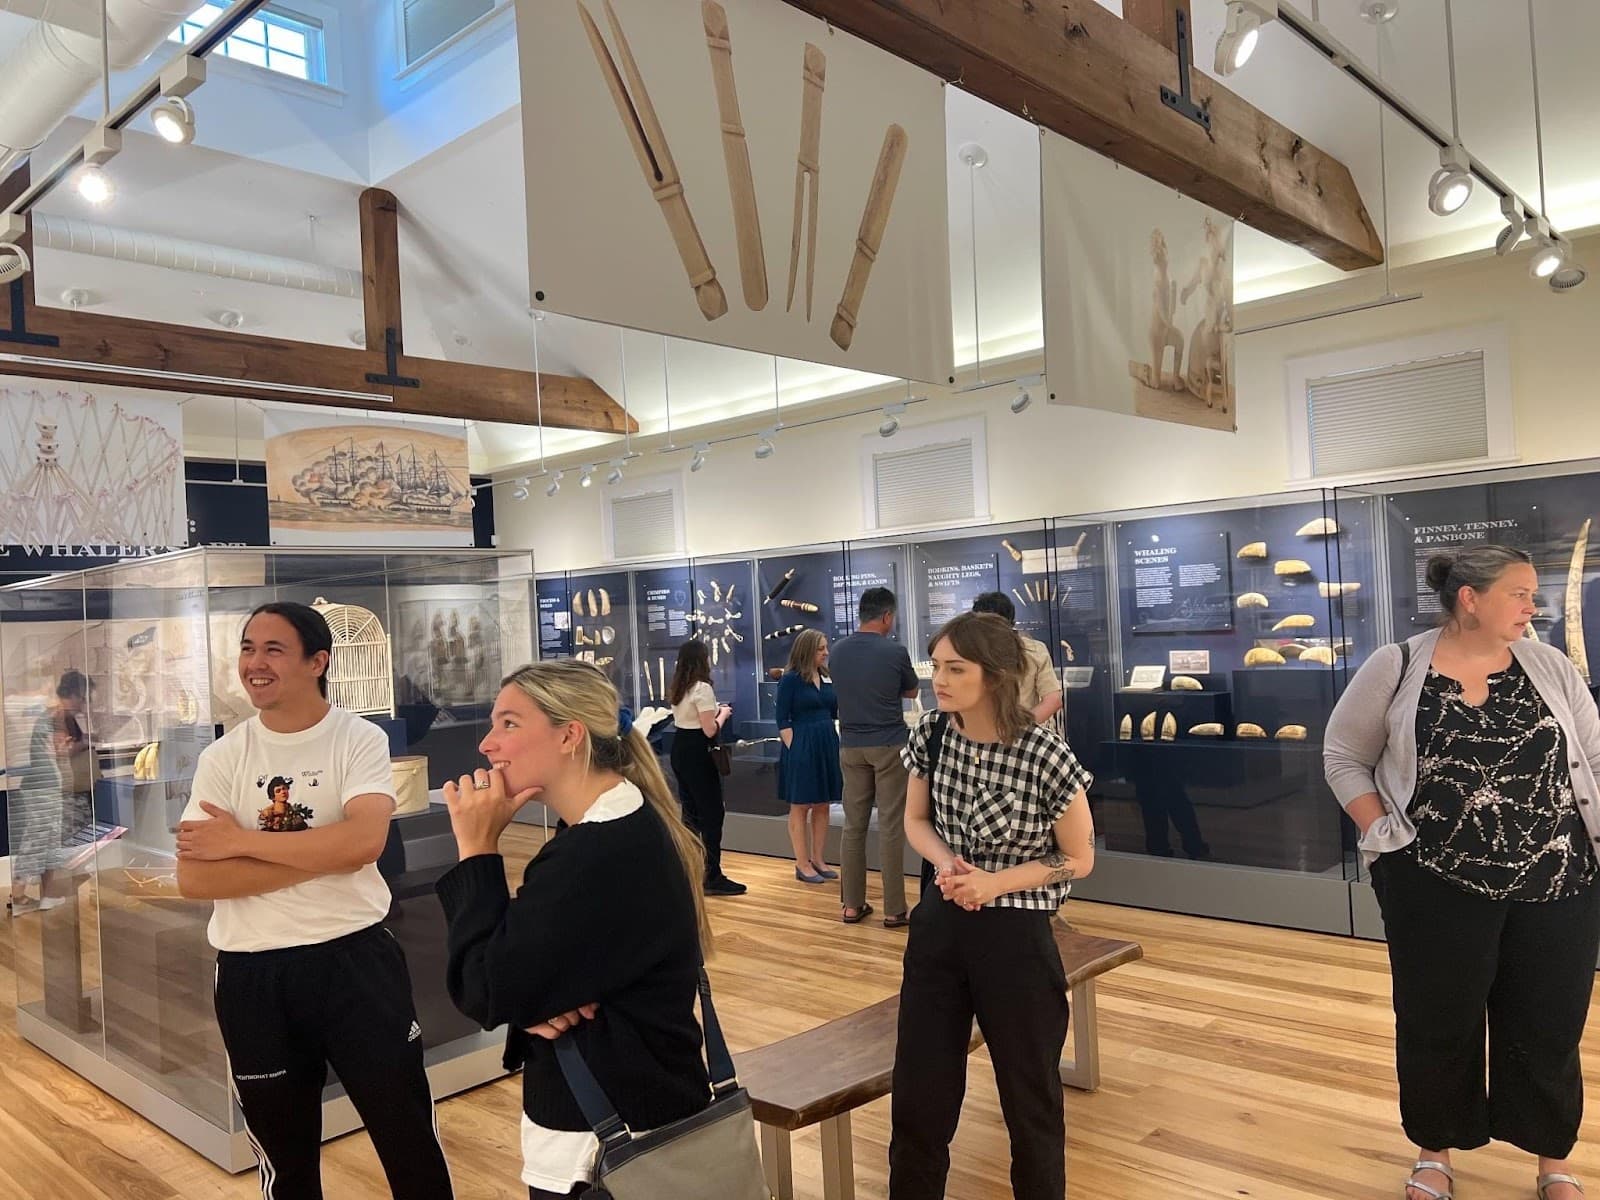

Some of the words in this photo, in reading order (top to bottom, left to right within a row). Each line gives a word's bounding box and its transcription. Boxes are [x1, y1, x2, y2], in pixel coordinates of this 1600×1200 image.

[1414, 523, 1462, 535] FINNEY,
[1464, 519, 1518, 531] TENNEY,
[1414, 535, 1424, 544] &
[1426, 531, 1486, 543] PANBONE
[1134, 547, 1177, 557] WHALING
[1135, 555, 1169, 565] SCENES
[833, 574, 860, 582] ROLLNG
[928, 573, 960, 581] NAUGHTY
